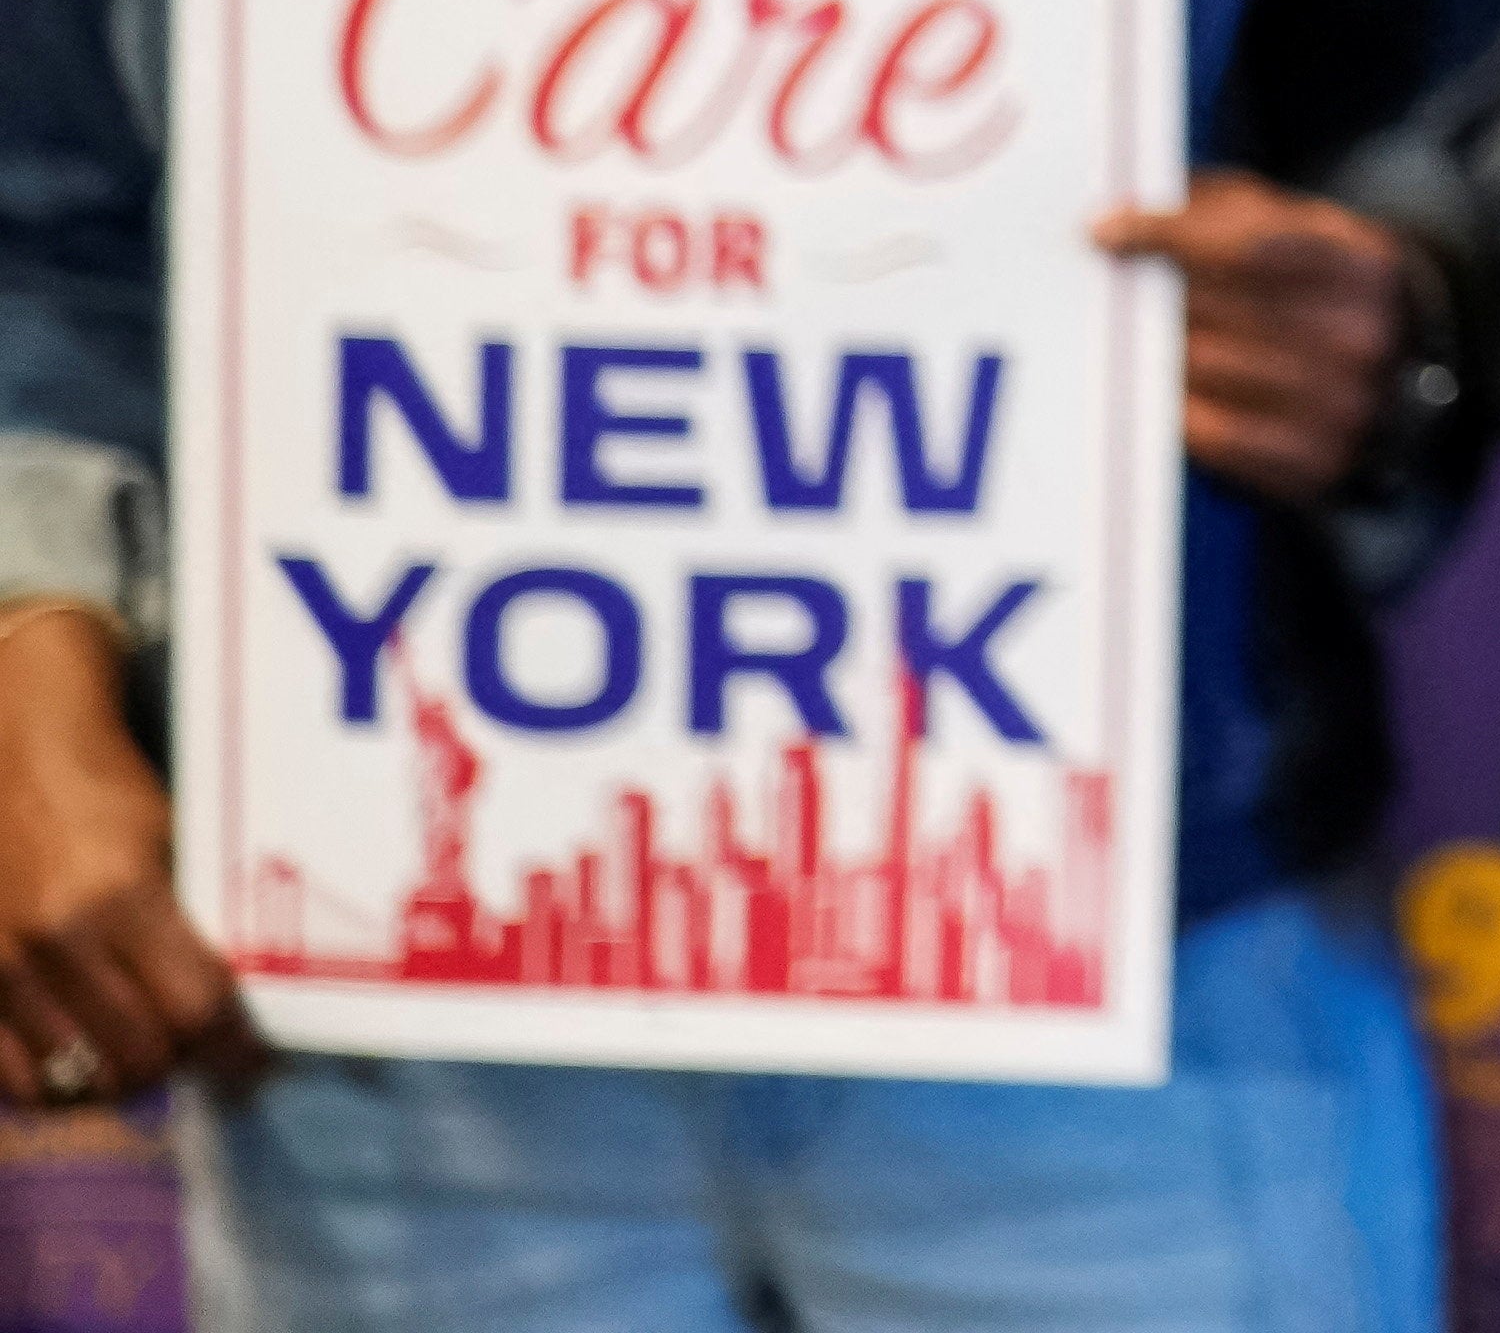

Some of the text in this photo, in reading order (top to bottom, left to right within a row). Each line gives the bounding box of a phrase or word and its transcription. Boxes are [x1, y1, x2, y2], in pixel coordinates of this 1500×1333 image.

[567, 205, 770, 295] FOR
[332, 333, 1006, 515] NEW
[275, 553, 1054, 749] YORK
